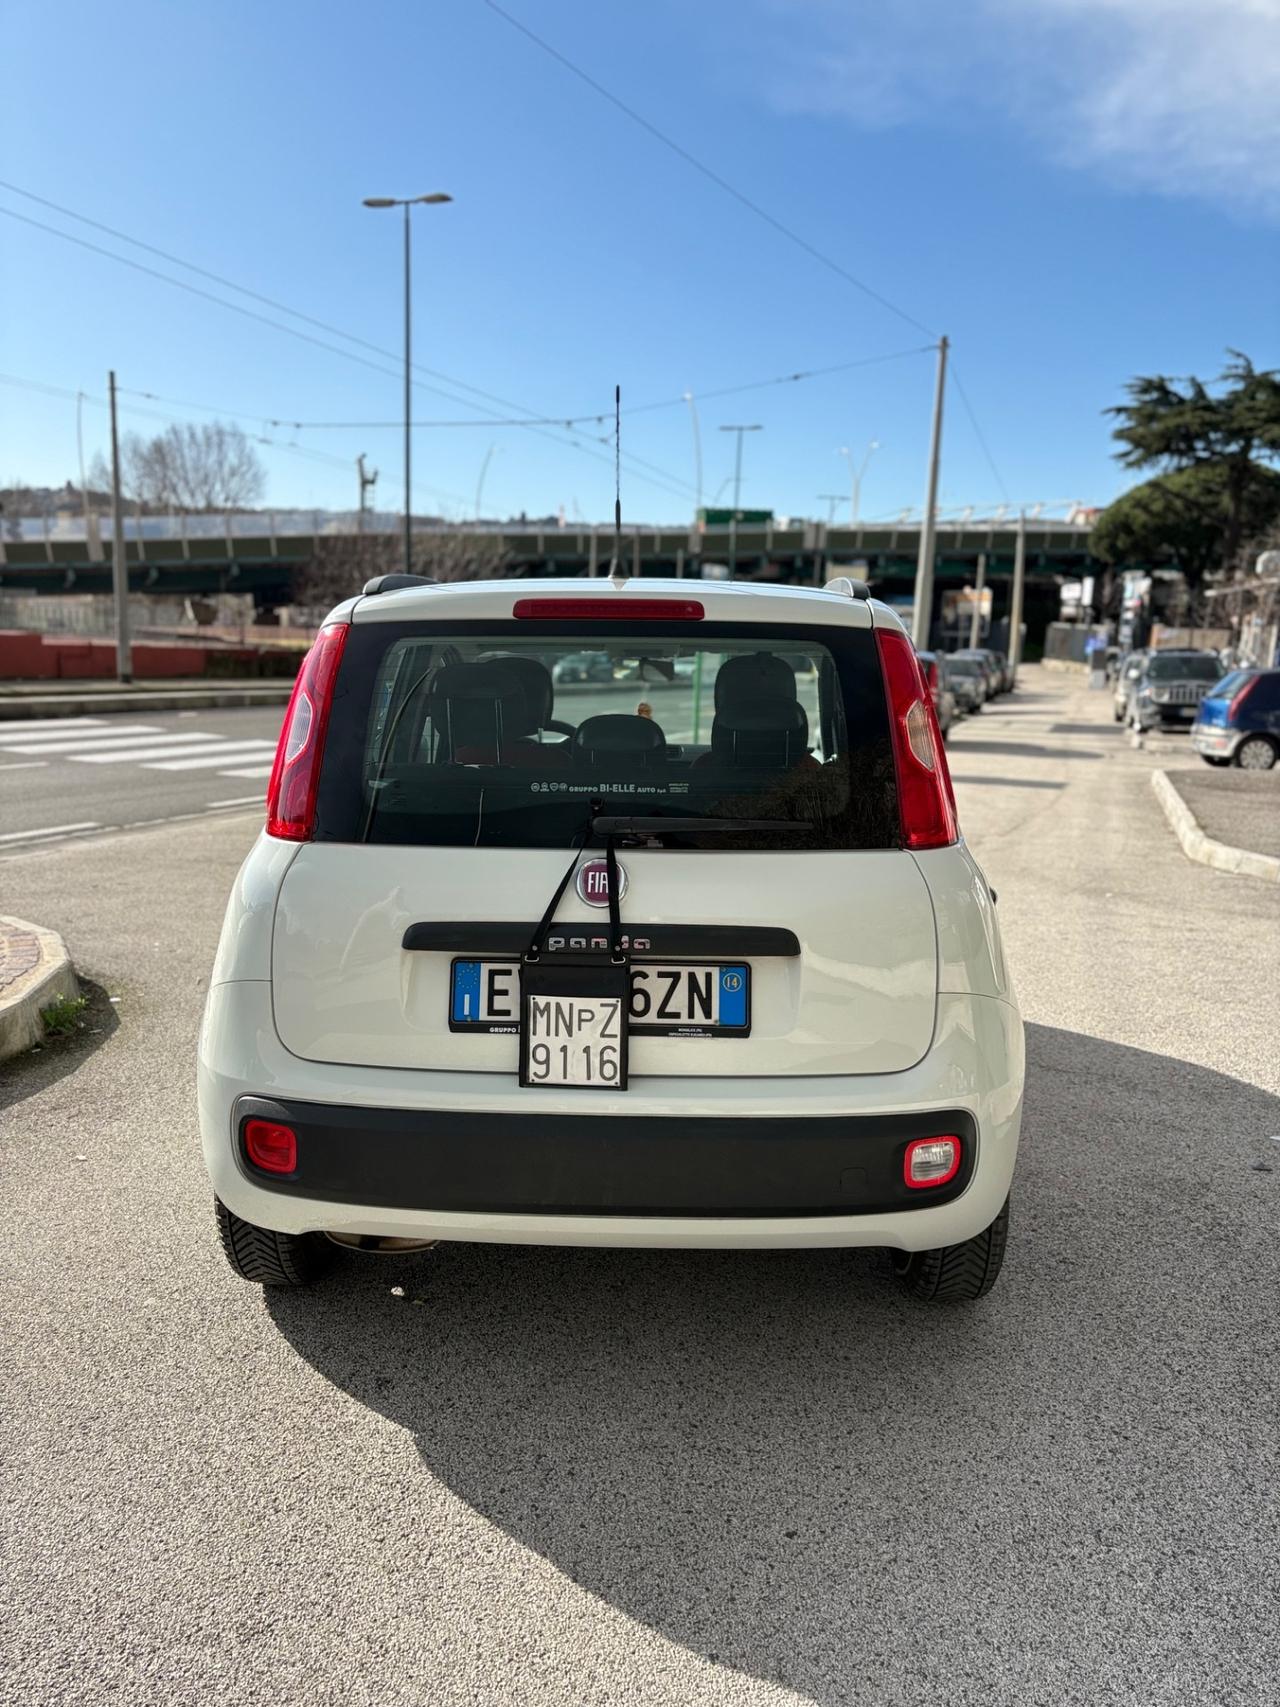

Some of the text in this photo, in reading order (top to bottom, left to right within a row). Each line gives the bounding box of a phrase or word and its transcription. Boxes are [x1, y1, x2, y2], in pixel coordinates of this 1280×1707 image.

[599, 784, 636, 793] BI-ELLE
[587, 871, 609, 893] FIA
[531, 1043, 619, 1081] 9116
